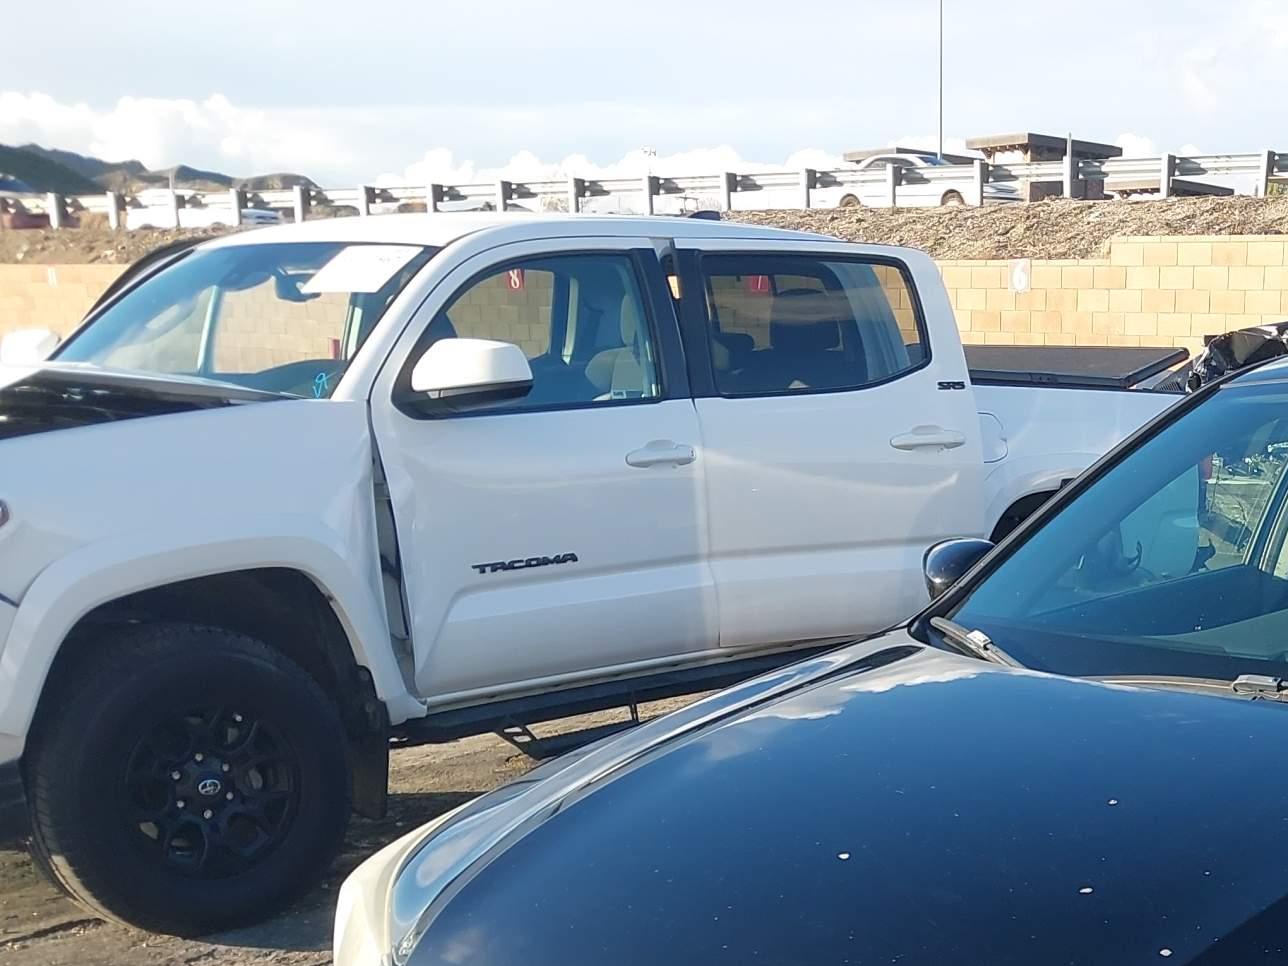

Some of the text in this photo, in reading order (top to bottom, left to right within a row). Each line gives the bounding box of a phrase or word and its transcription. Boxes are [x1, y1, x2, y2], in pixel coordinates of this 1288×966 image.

[509, 269, 520, 289] 8
[1012, 259, 1027, 291] 6
[937, 381, 966, 390] SR5
[471, 552, 579, 574] TACOMA
